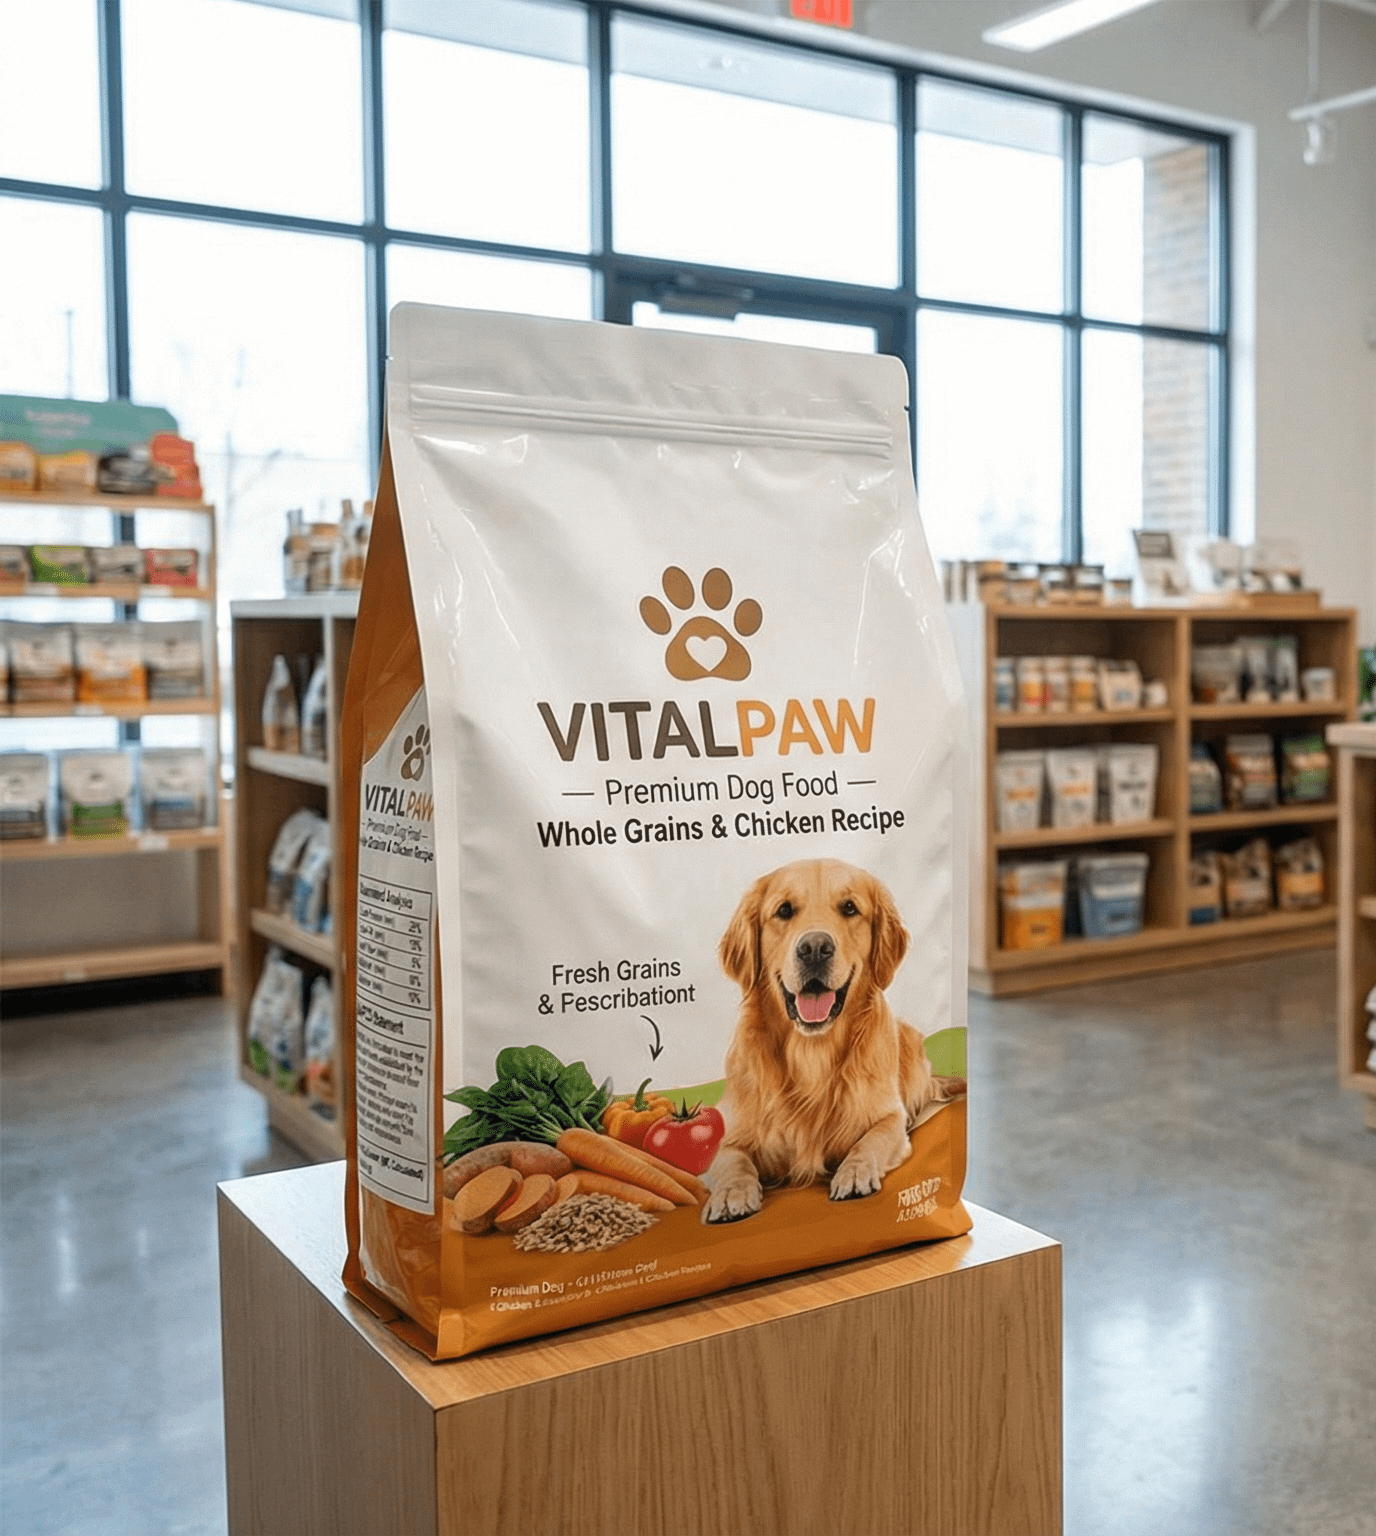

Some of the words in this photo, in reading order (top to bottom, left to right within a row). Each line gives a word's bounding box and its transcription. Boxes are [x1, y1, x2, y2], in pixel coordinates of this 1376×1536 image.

[536, 698, 875, 761] VITALPAW
[605, 775, 719, 806] Premium
[727, 774, 775, 805] Dog
[781, 770, 839, 798] Food
[536, 819, 617, 849] Whole
[624, 815, 704, 844] Grains
[711, 813, 729, 839] &
[734, 810, 825, 838] Chicken
[831, 805, 905, 835] Recipe
[552, 960, 610, 986] Fresh
[616, 957, 682, 982] Grains
[537, 993, 555, 1016] &
